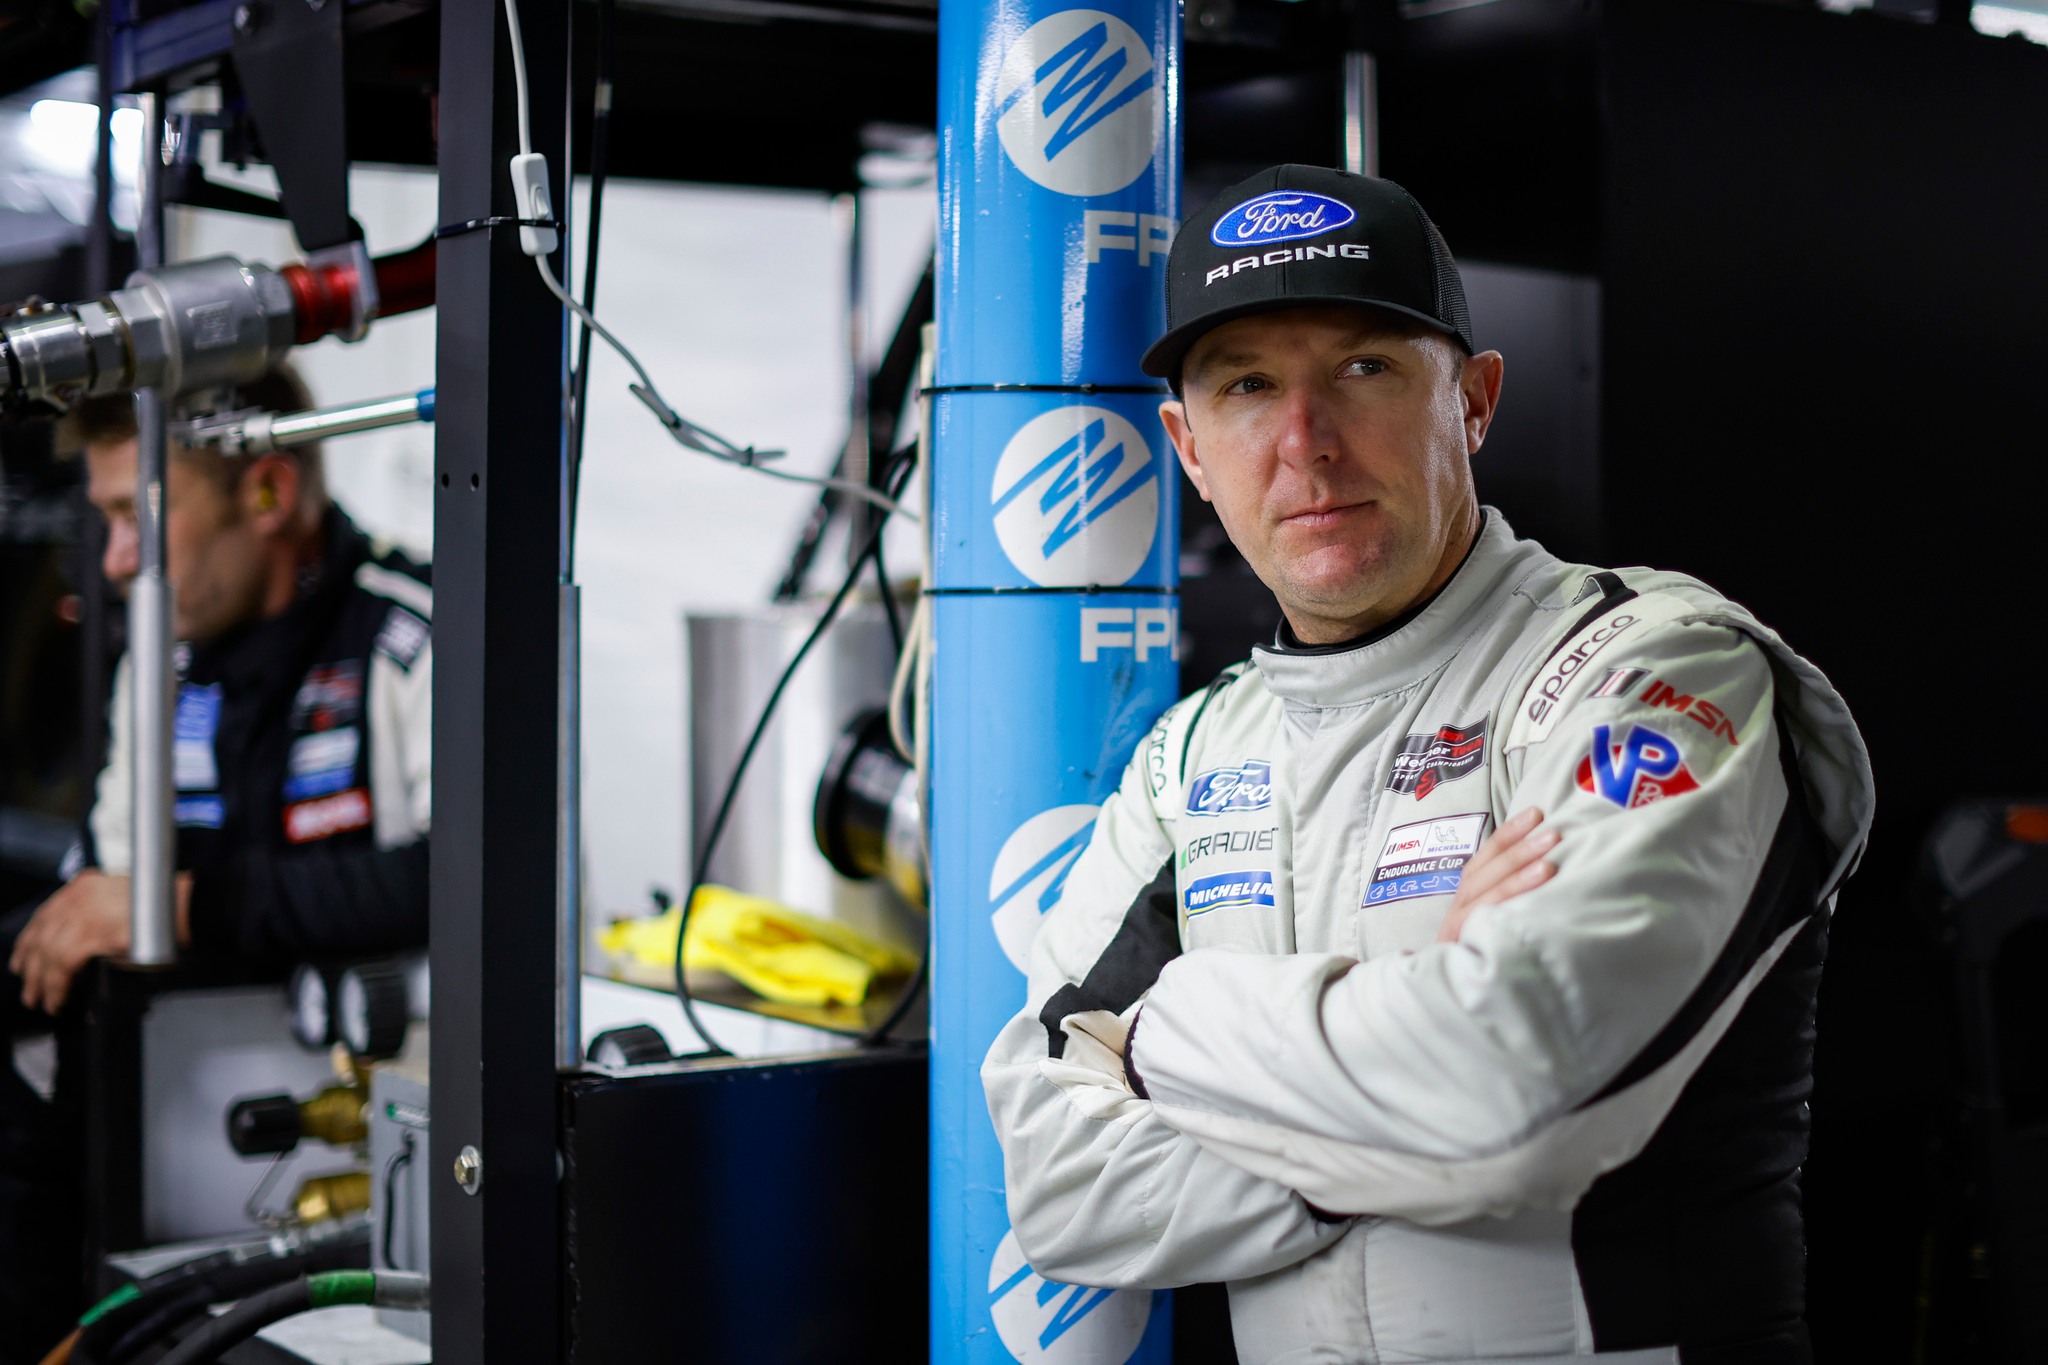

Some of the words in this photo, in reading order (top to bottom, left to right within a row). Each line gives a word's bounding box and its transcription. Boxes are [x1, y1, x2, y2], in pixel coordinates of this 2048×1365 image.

[1237, 198, 1326, 239] Ford
[1204, 244, 1370, 286] RACING
[1640, 680, 1740, 746] IMSA
[1591, 723, 1681, 810] VP
[1427, 843, 1471, 853] MICHELIN
[1190, 881, 1273, 906] MICHELIN
